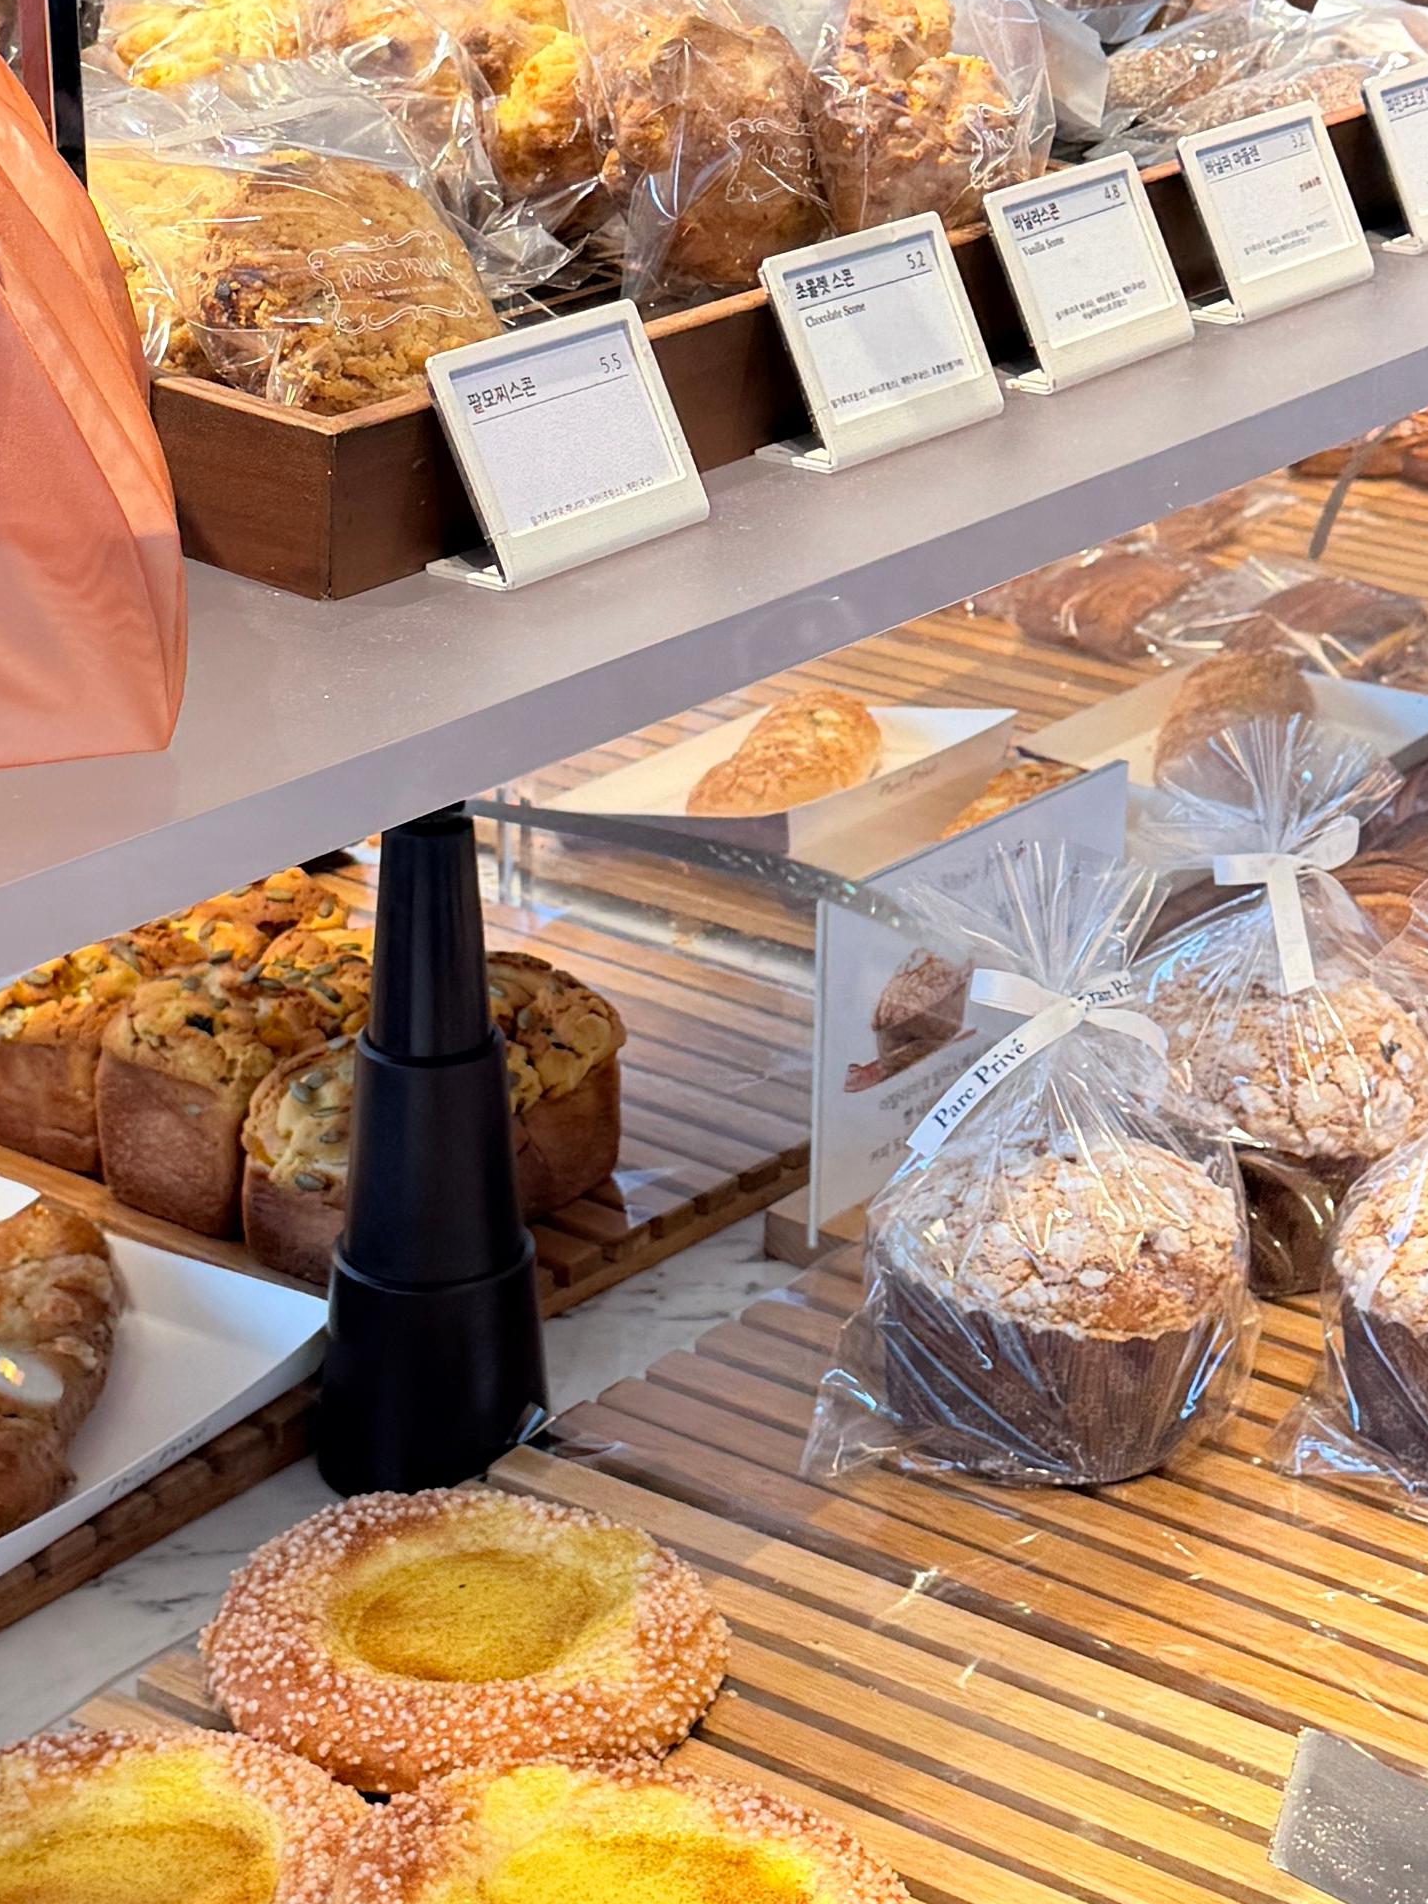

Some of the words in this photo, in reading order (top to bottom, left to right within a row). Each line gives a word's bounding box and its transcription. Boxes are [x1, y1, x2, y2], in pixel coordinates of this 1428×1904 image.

[1011, 202, 1061, 232] 바닐라스콘
[832, 268, 855, 289] 스콘
[906, 250, 927, 271] 5.2
[804, 306, 842, 329] Chocolate
[842, 301, 866, 318] Scone
[599, 351, 623, 375] 5.5
[933, 1086, 977, 1131] Parc
[972, 1037, 1027, 1086] Privé
